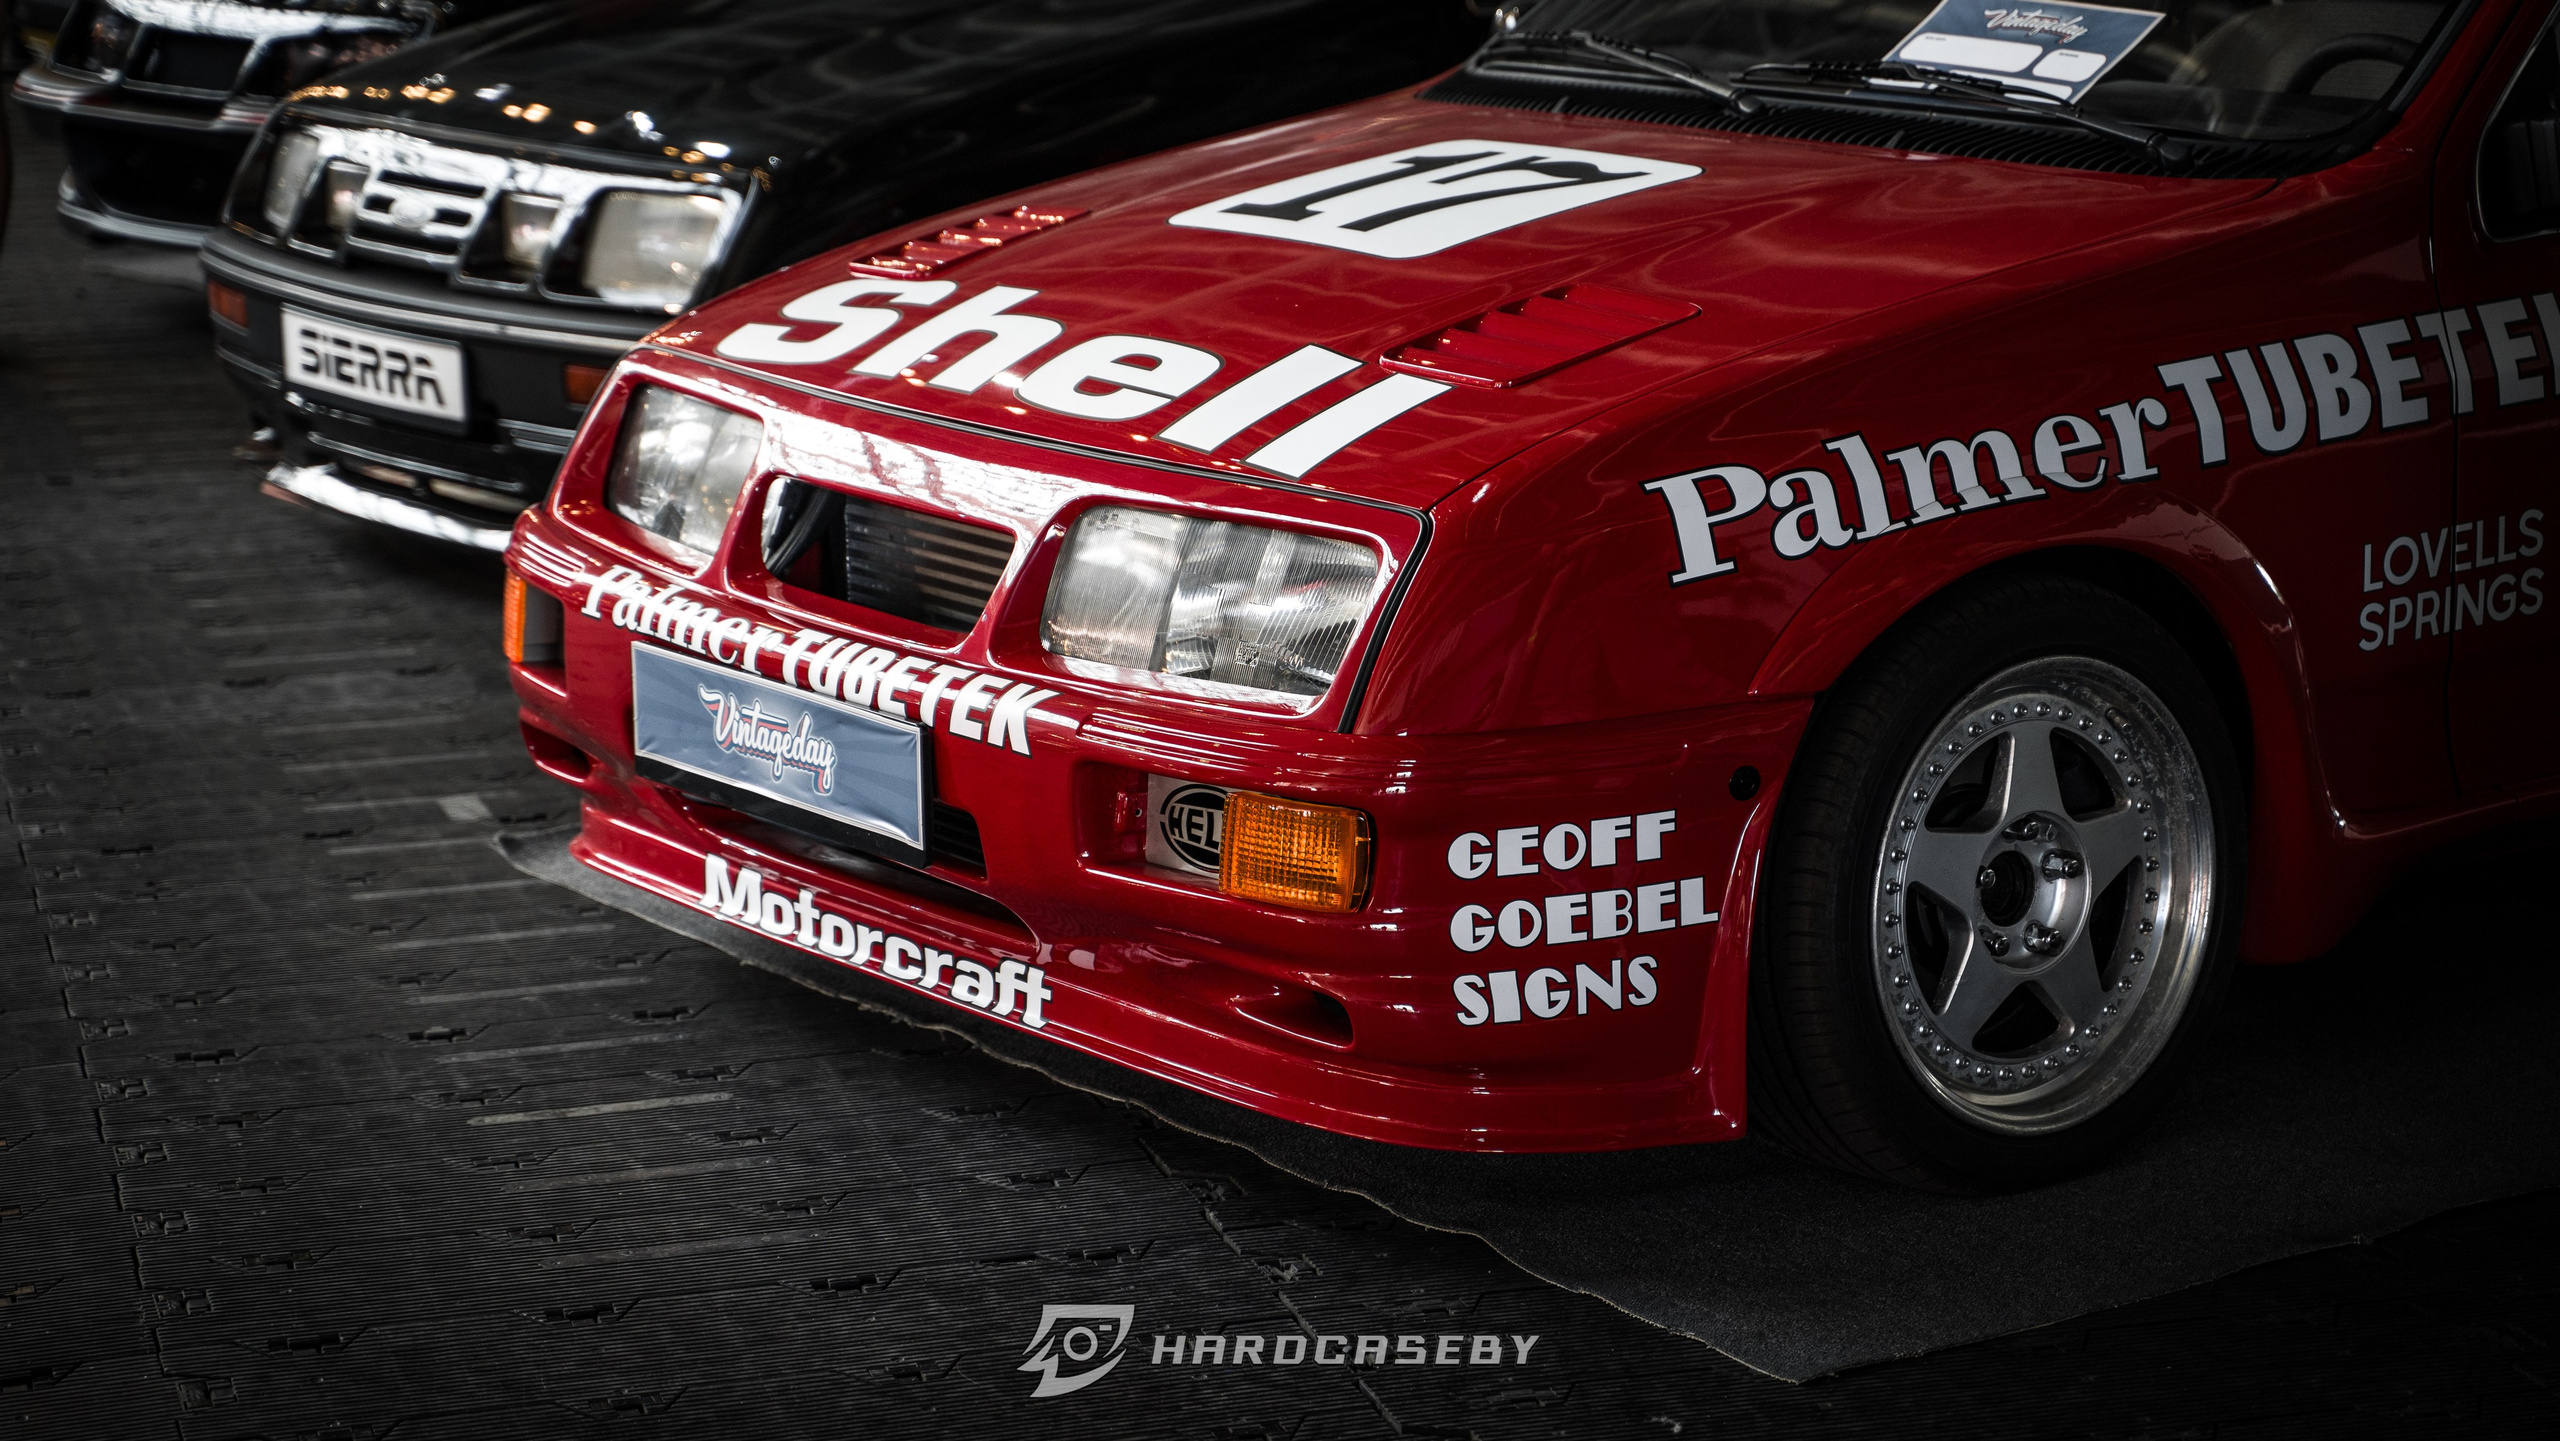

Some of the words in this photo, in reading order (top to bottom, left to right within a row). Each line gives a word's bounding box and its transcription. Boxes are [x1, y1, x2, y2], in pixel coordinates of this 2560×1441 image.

[1984, 8, 2088, 43] Vintageday
[1218, 150, 1653, 232] 17
[300, 328, 446, 406] SIERRA
[715, 279, 1453, 479] Shell
[2362, 508, 2545, 593] LOVELLS
[2358, 567, 2545, 651] SPRINGS
[699, 685, 836, 794] Vintageday
[1168, 805, 1224, 851] HEL
[1447, 809, 1677, 880] GEOFF
[699, 853, 1053, 1029] Motorcraft
[1449, 876, 1719, 952] GOEBEL
[1453, 955, 1658, 1026] SIGNS
